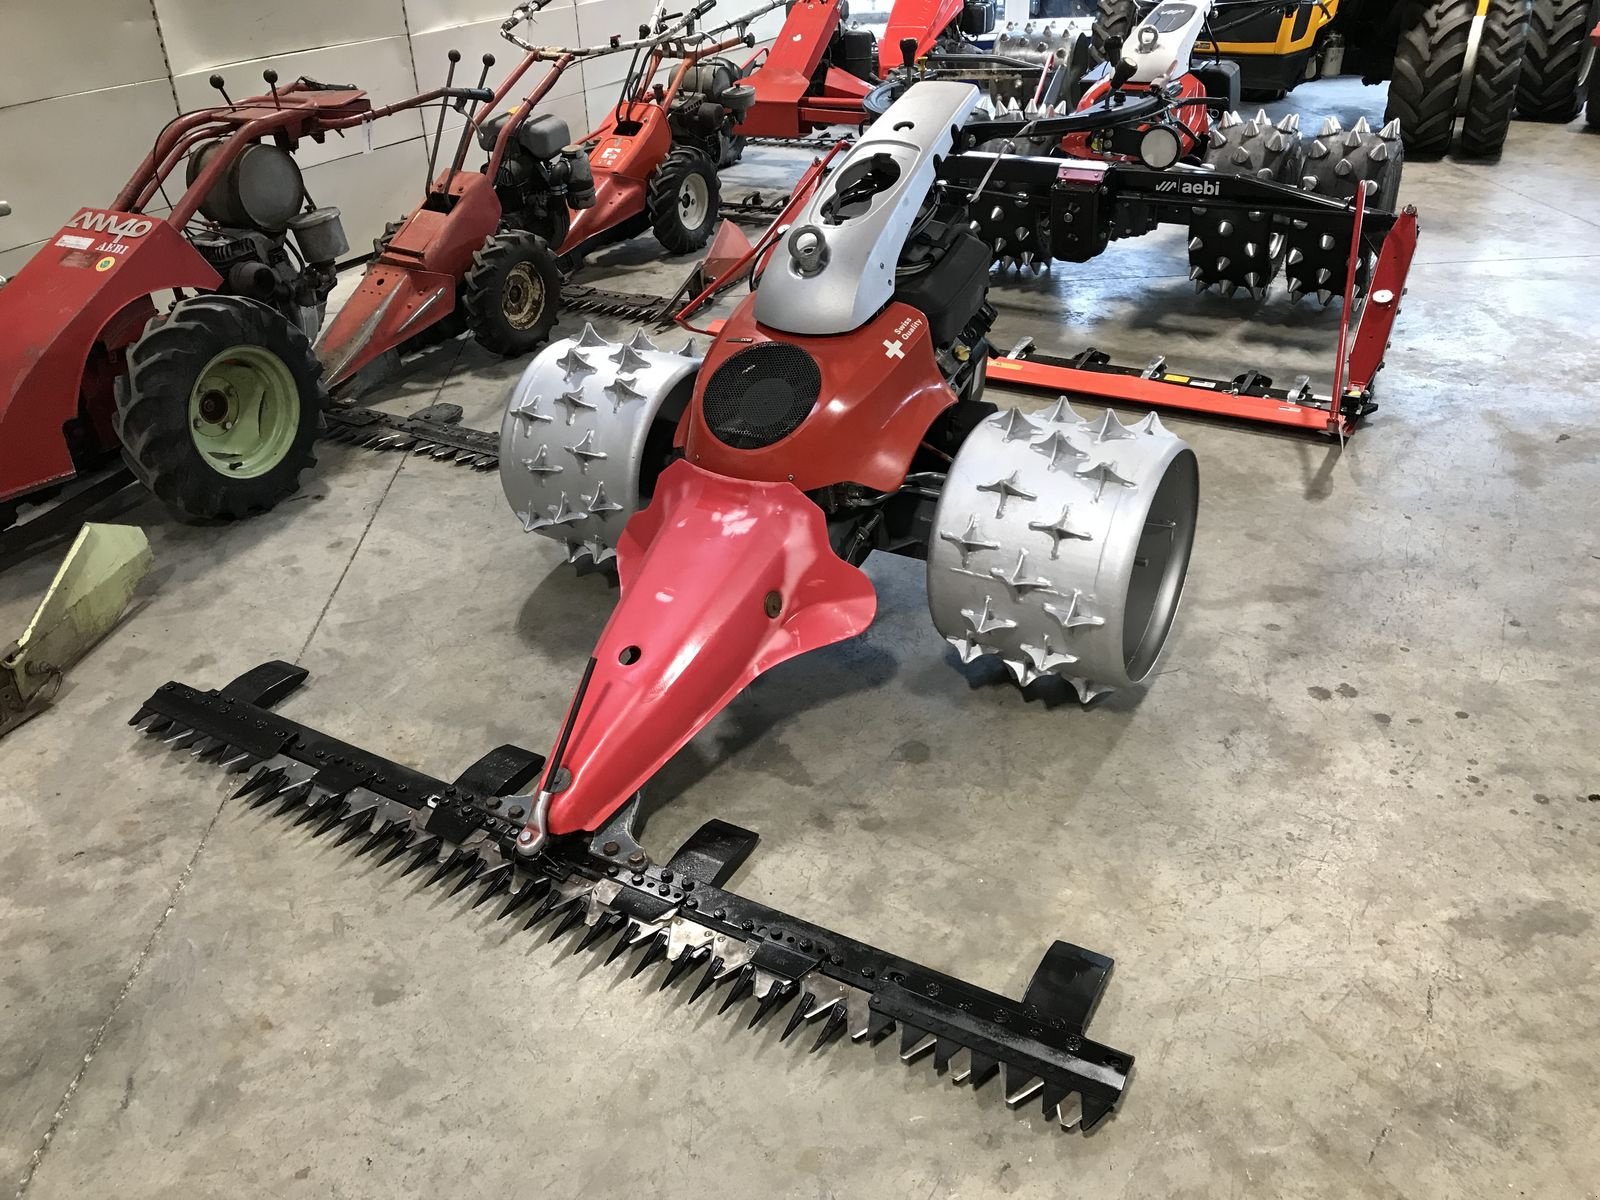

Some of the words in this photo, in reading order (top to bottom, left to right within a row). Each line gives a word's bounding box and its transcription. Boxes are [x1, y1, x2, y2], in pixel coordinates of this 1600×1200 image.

[1181, 181, 1220, 195] aebi
[95, 242, 129, 254] AEBI
[894, 317, 912, 335] Swiss
[901, 318, 922, 340] Quality
